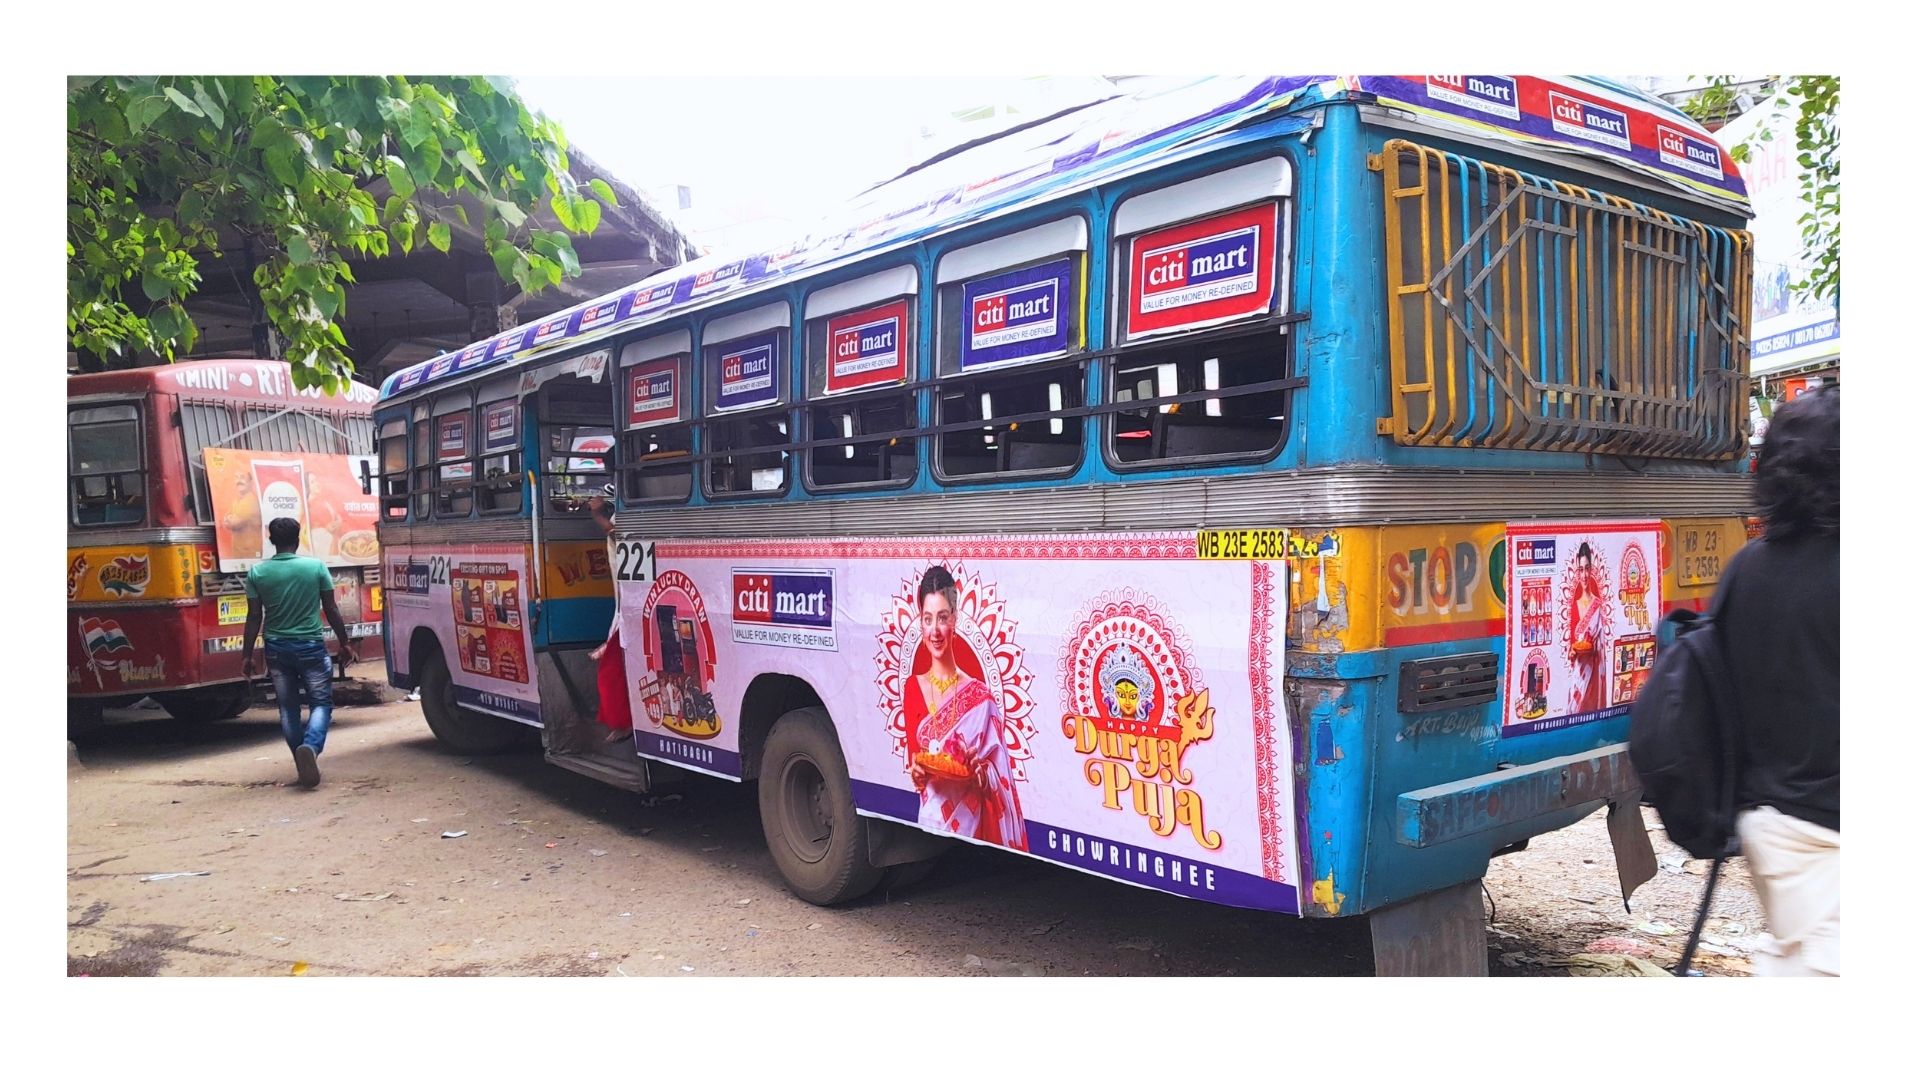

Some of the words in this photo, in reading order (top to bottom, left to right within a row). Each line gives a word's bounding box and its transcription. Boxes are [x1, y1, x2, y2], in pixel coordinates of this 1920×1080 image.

[1468, 78, 1510, 101] mart
[1556, 100, 1583, 122] citi
[1586, 113, 1623, 134] mart
[1663, 134, 1684, 154] citi
[1687, 146, 1717, 165] mart
[714, 262, 741, 281] mart
[1150, 251, 1184, 285] citi
[1191, 244, 1247, 277] mart
[651, 283, 674, 300] mart
[1143, 299, 1164, 310] VALUE
[1166, 295, 1180, 306] FOR
[1182, 290, 1207, 302] MONEY
[1208, 281, 1254, 297] RE-DEFINED
[597, 303, 616, 318] mart
[978, 297, 1003, 326] citi
[1008, 294, 1050, 320] mart
[838, 332, 858, 357] citi
[861, 330, 892, 352] mart
[725, 357, 741, 378] citi
[743, 355, 767, 375] mart
[636, 379, 649, 398] citi
[651, 380, 670, 395] mart
[1197, 532, 1219, 558] WB
[1223, 531, 1248, 558] 23E
[1252, 530, 1284, 558] 2583
[1518, 542, 1533, 560] citi
[1534, 546, 1554, 560] mart
[1685, 530, 1698, 553] WB
[1704, 531, 1718, 551] 23
[430, 555, 451, 586] 221
[617, 542, 656, 581] 221
[1695, 555, 1720, 578] 2583
[395, 566, 408, 588] citi
[409, 571, 428, 589] mart
[1387, 540, 1481, 616] STOP
[643, 588, 658, 619] WIN
[655, 572, 684, 593] LUCKY
[684, 580, 707, 623] DRAW
[738, 577, 769, 613] citi
[775, 588, 826, 617] mart
[734, 629, 754, 640] VALUE
[754, 630, 767, 641] FOR
[768, 632, 792, 643] MONEY
[793, 634, 834, 648] RE-DEFINED
[1107, 720, 1159, 735] HAPPY
[1062, 714, 1192, 785] Durga
[1084, 758, 1222, 850] Puja
[1048, 830, 1216, 891] CHOWRINGHEE
